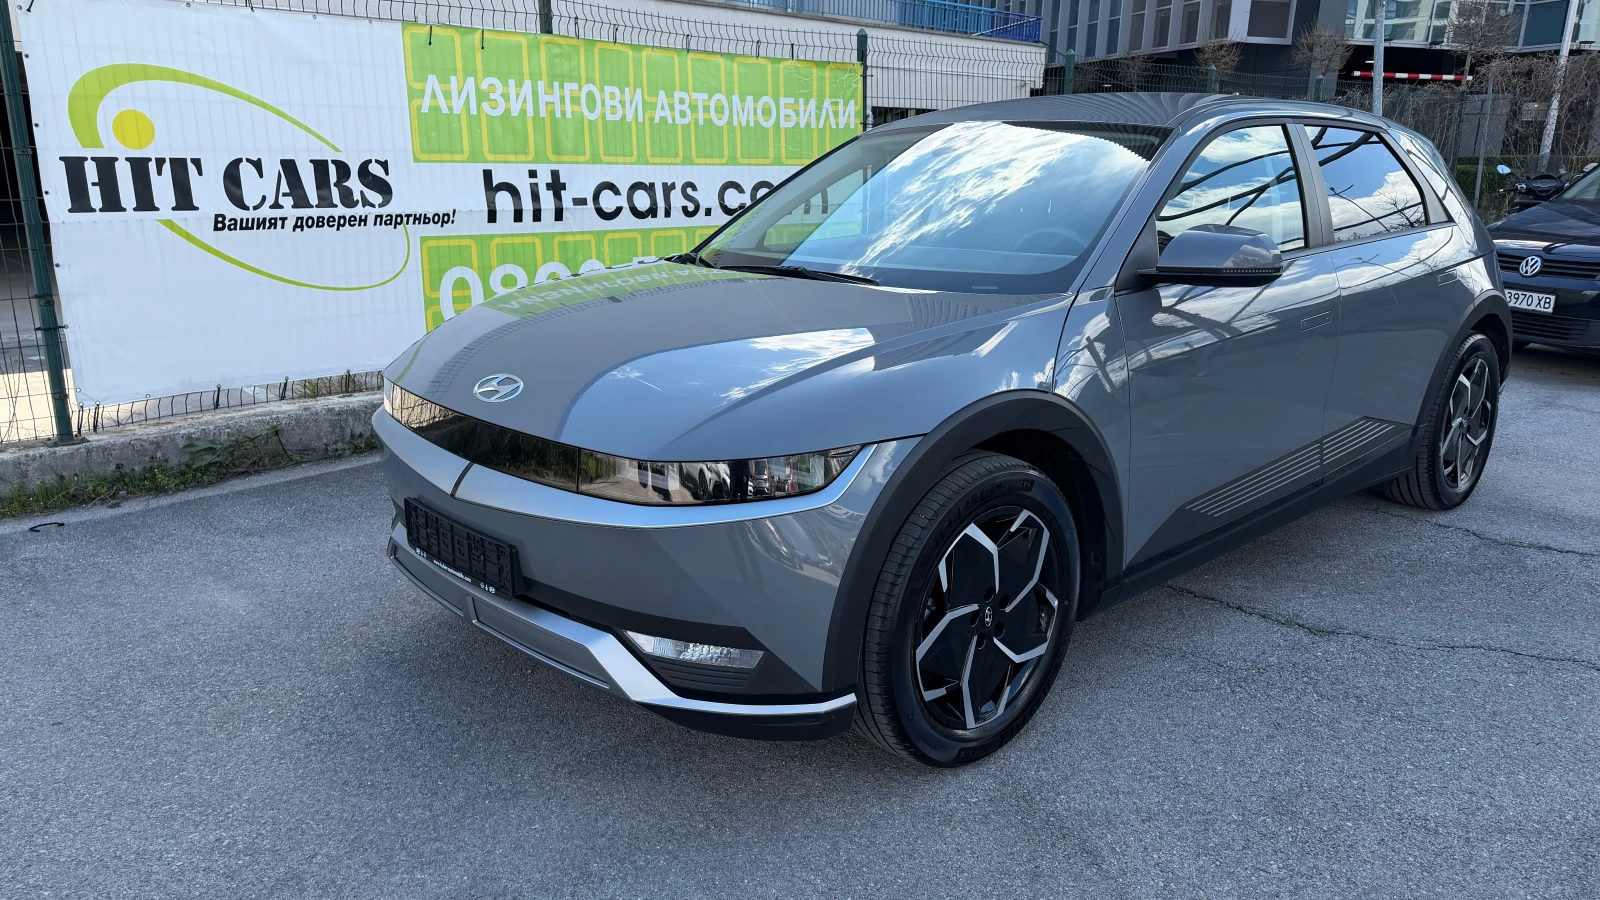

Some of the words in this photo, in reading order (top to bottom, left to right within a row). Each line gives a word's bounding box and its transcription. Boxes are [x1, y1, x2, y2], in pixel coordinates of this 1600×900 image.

[421, 74, 643, 123] ЛИЗИНГОВИ
[654, 89, 856, 129] АВТОМОБИЛИ
[59, 156, 203, 213] HIT
[223, 157, 393, 212] CARS
[213, 213, 288, 232] Вашият
[292, 211, 368, 232] доверен
[373, 209, 457, 230] партньор!
[1507, 291, 1534, 307] 3970
[1535, 295, 1552, 310] XB
